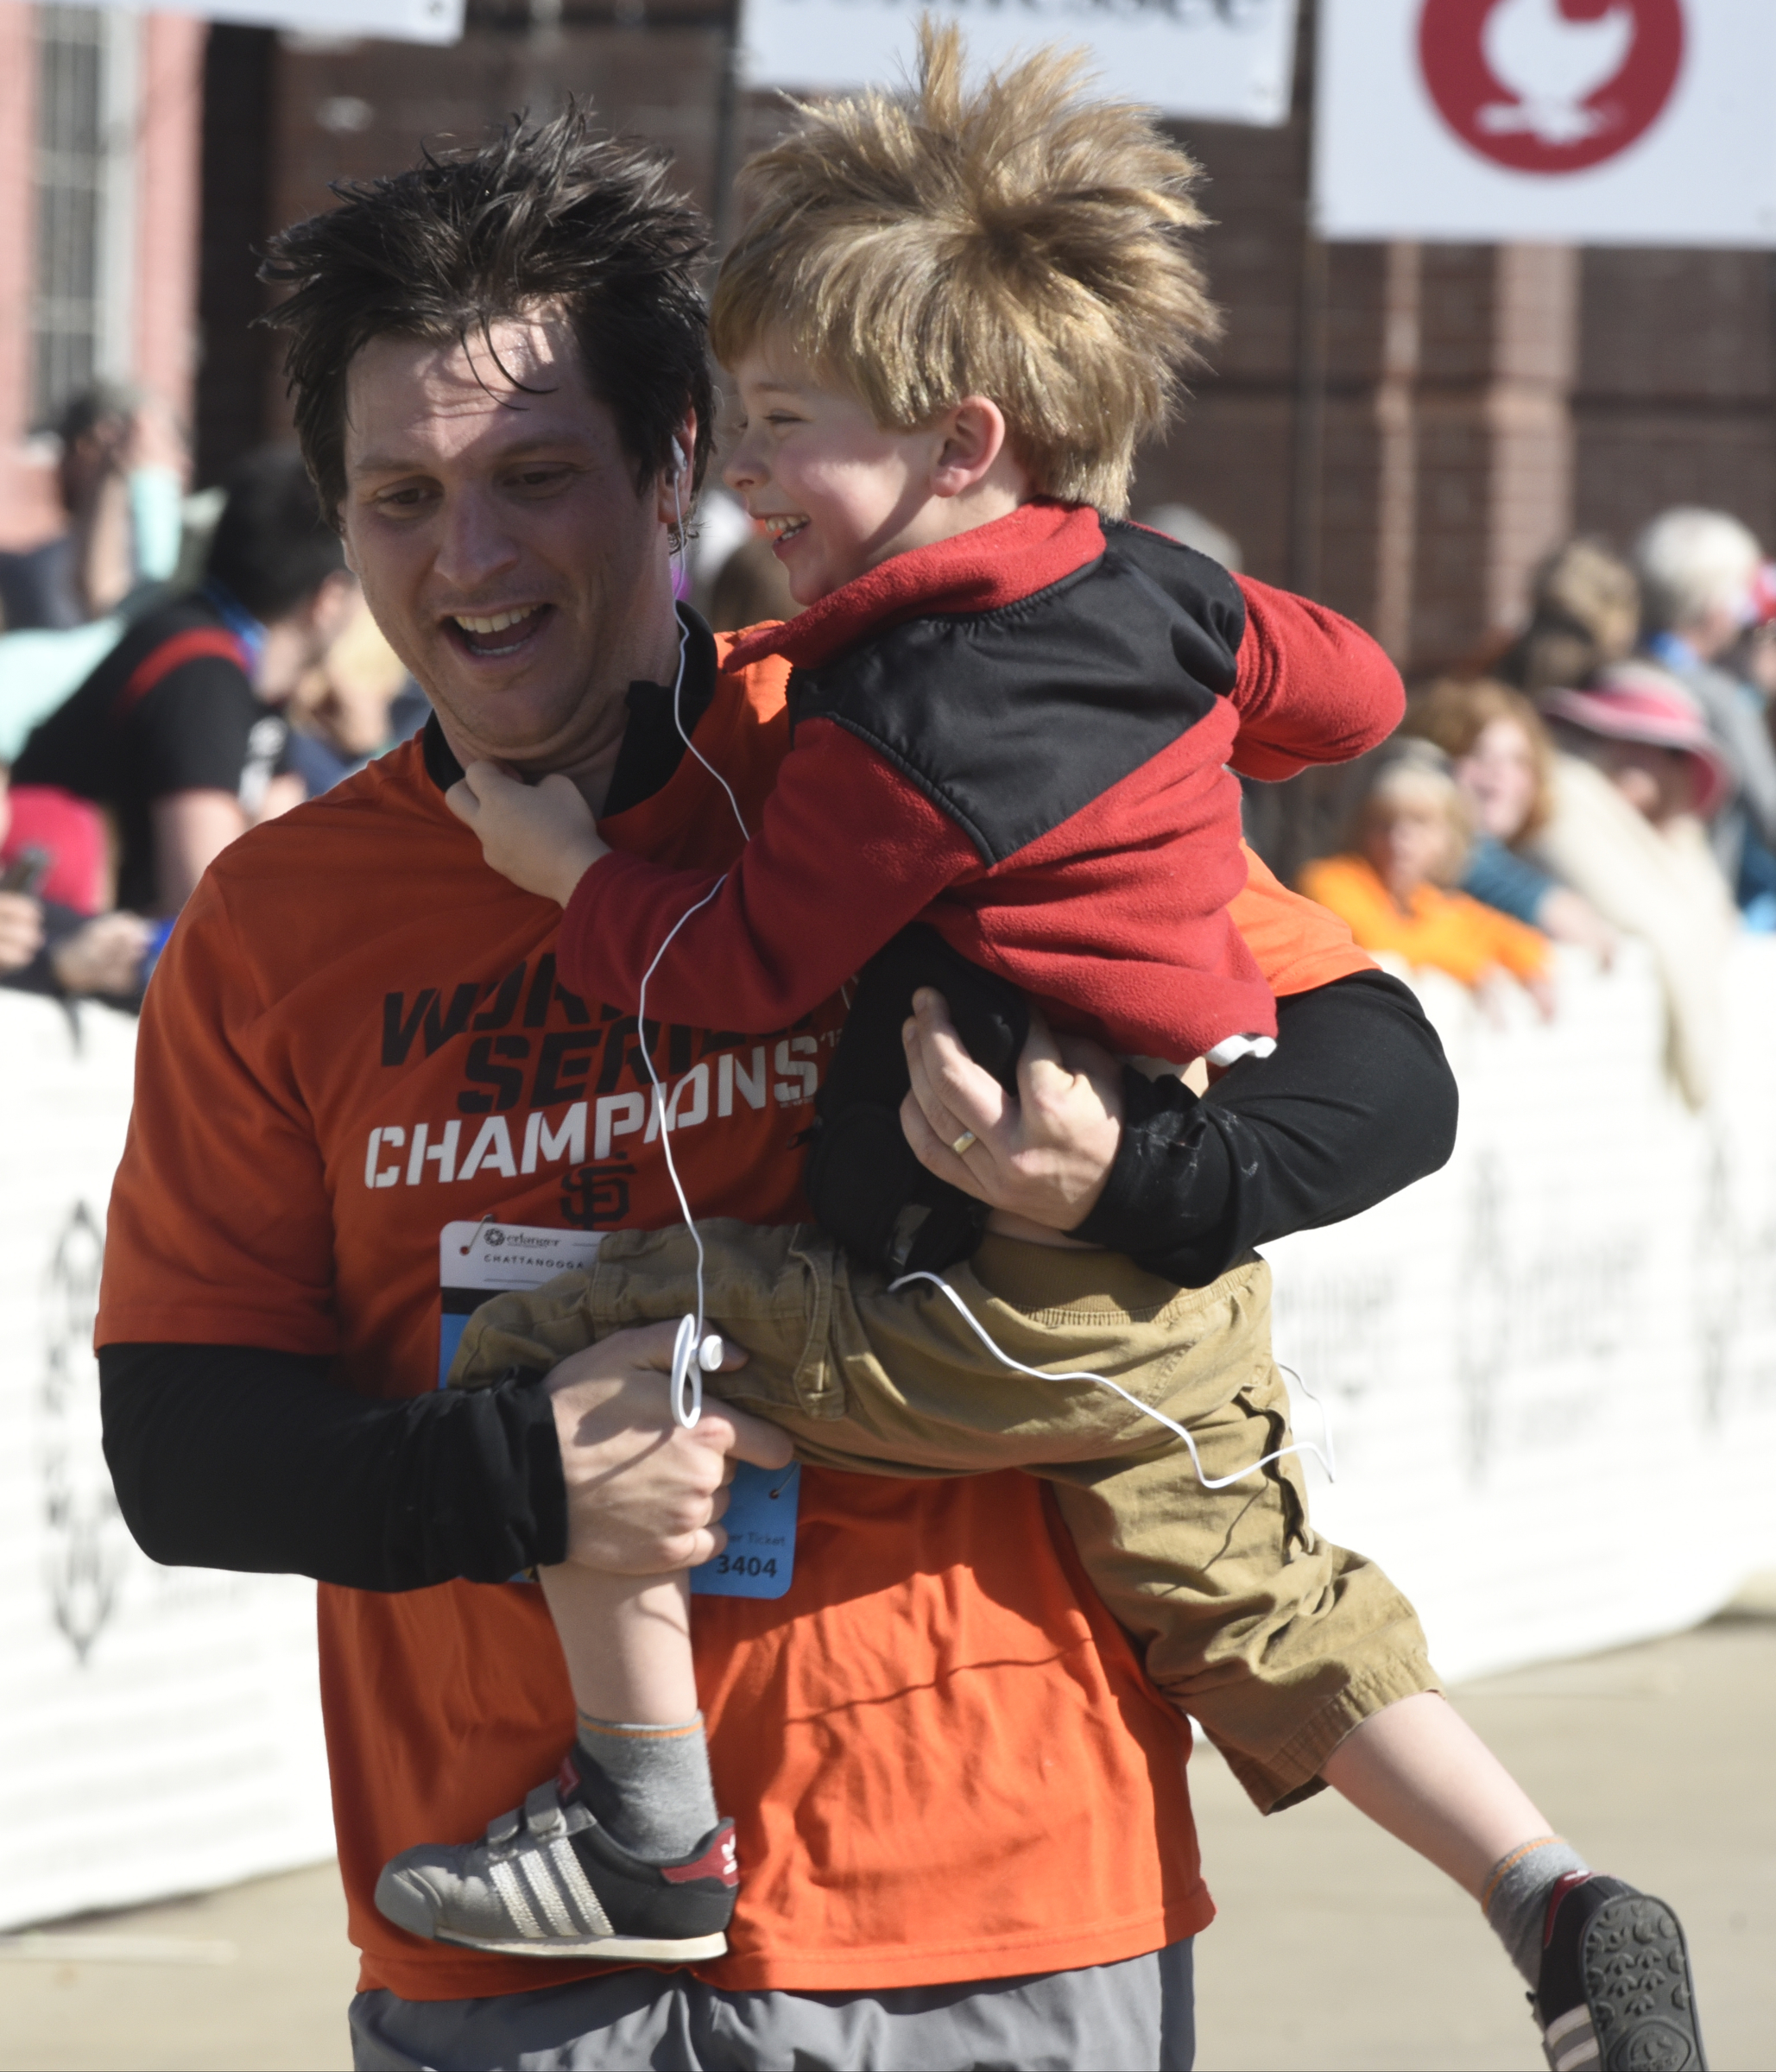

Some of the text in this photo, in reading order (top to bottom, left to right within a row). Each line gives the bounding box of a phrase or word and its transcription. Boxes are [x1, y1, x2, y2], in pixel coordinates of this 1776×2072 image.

[364, 1035, 818, 1190] CHAMPIONS
[507, 1233, 560, 1249] erlanger
[484, 1254, 584, 1269] CHATTANOOGA
[748, 1531, 785, 1547] Ticket
[716, 1554, 778, 1578] 3404
